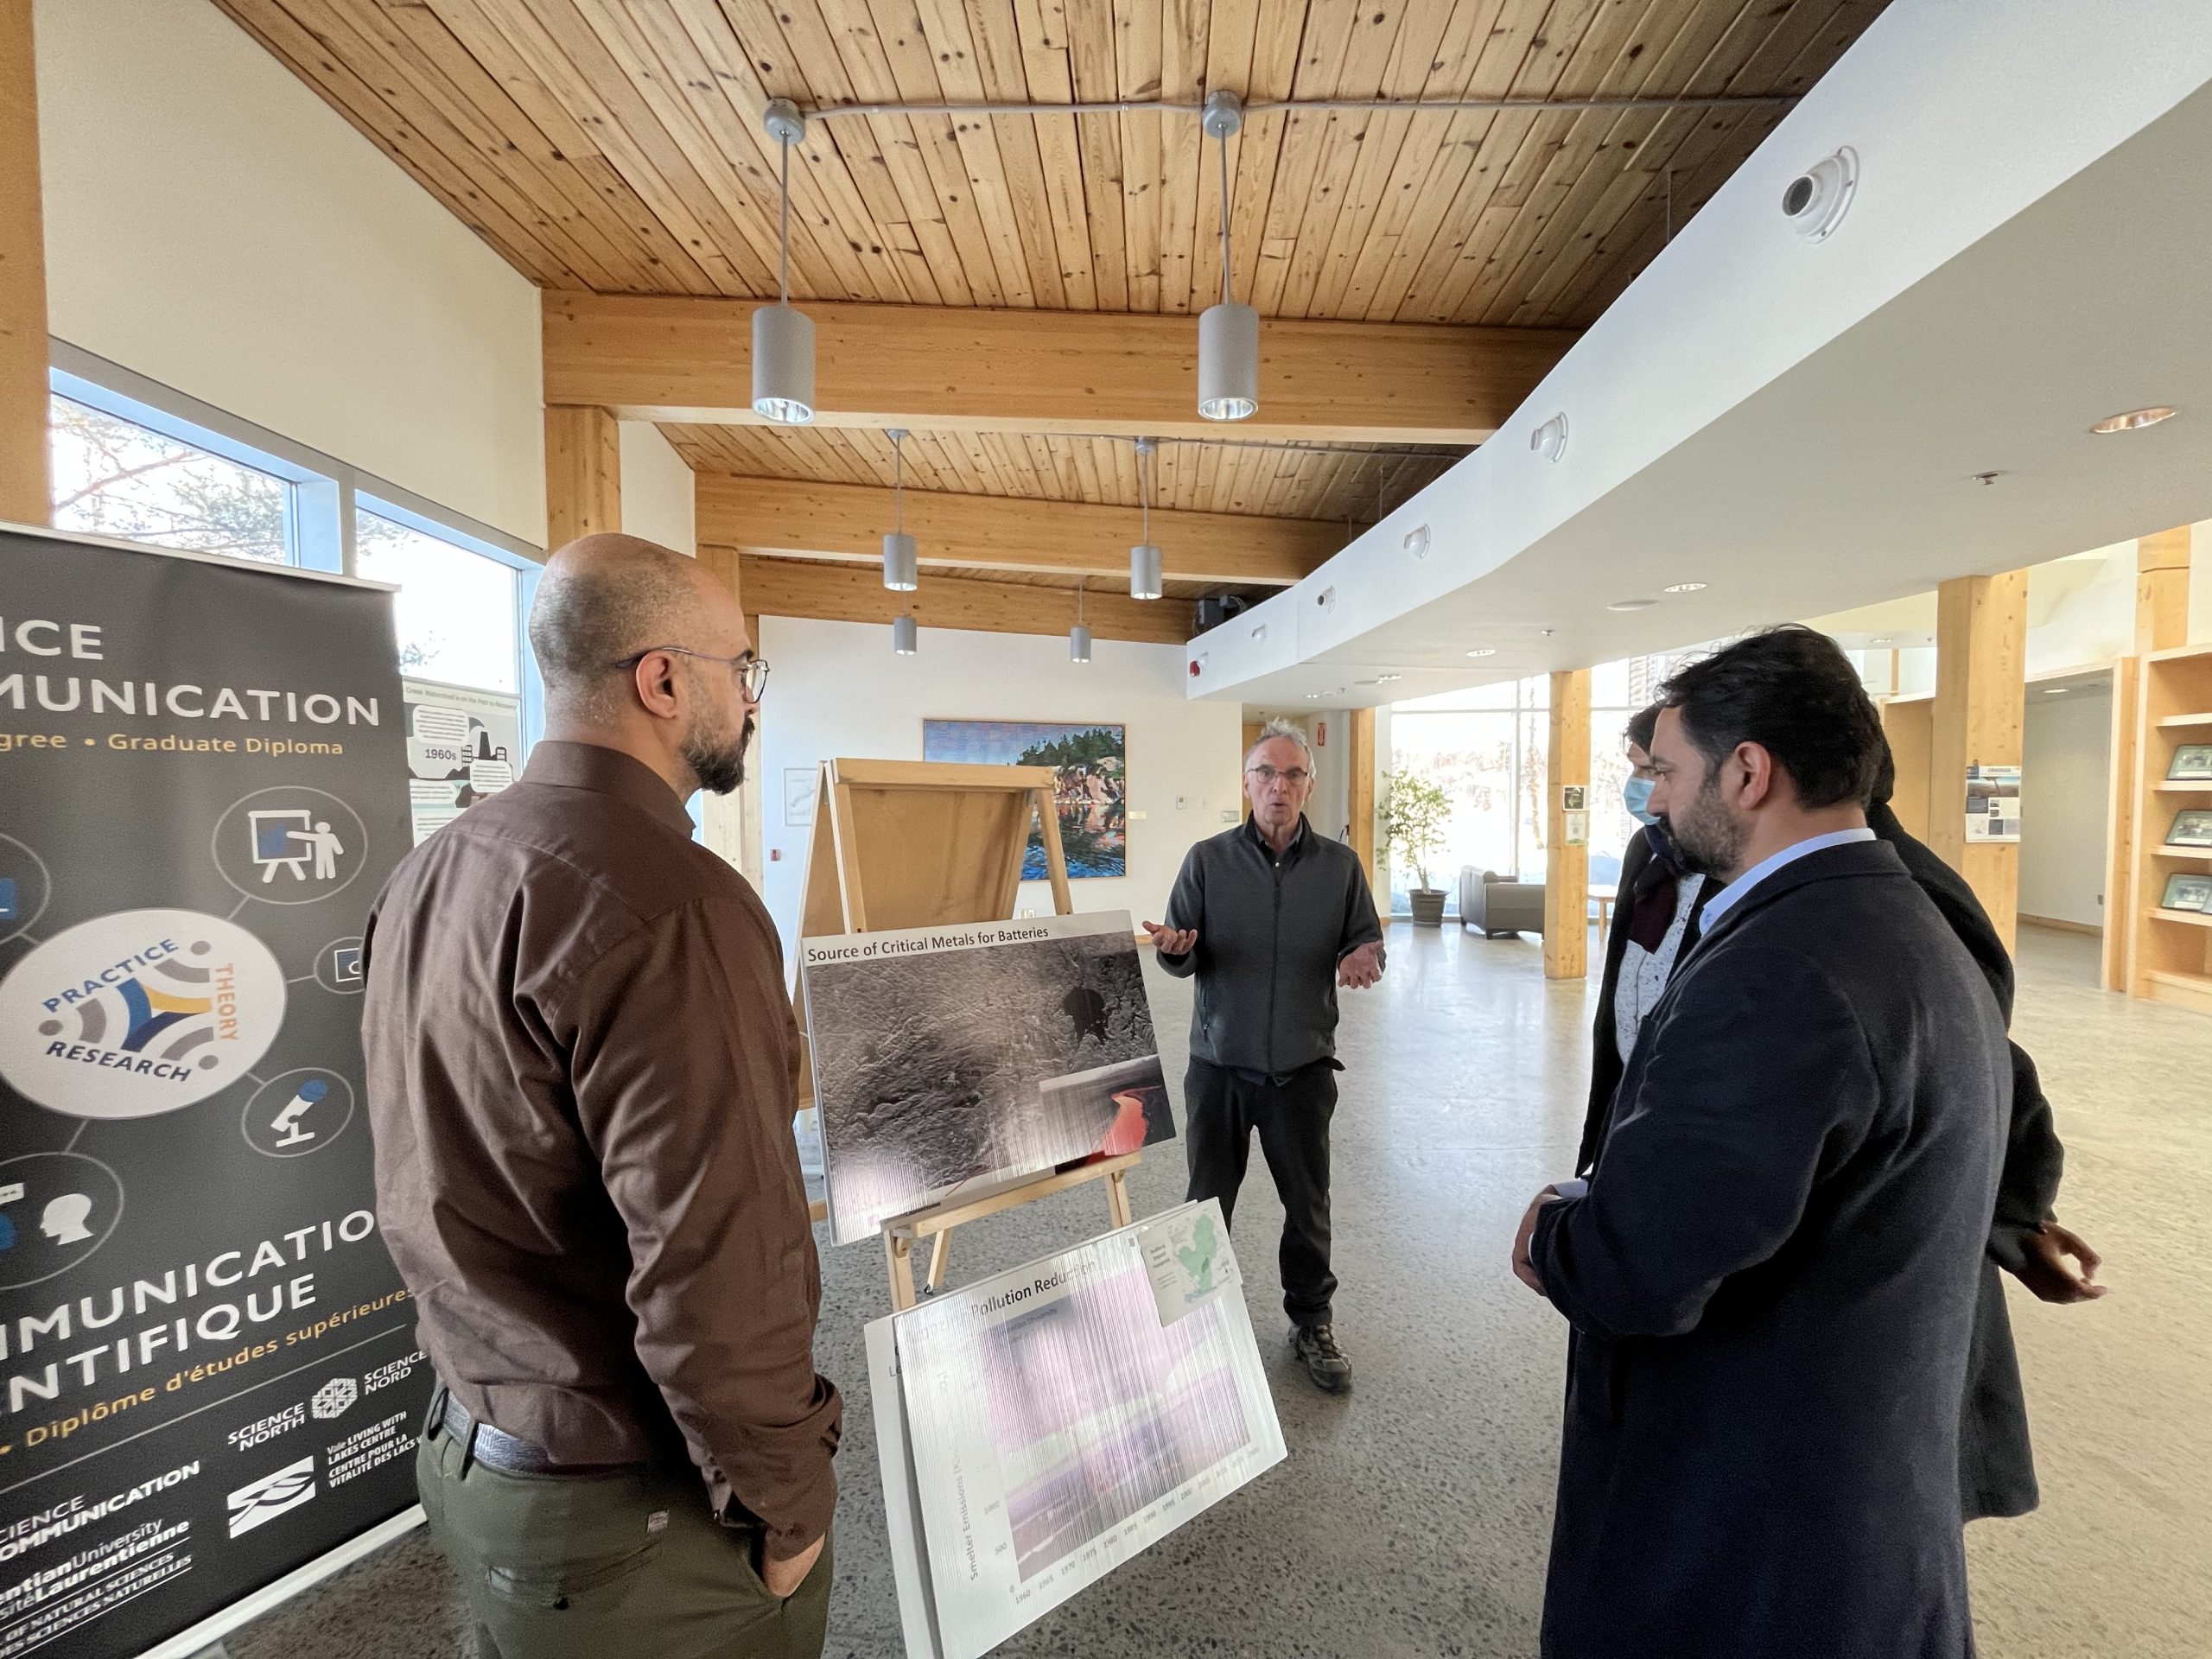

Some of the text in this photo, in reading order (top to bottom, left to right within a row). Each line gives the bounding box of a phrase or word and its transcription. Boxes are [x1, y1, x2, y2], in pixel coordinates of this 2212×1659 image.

[0, 616, 103, 660] CE
[108, 734, 236, 753] Graduate
[246, 738, 343, 757] Diploma
[425, 748, 457, 760] 1960s
[808, 926, 1048, 962] Source of Critical Metals for Batteries
[41, 938, 179, 1014] PRACTICE
[215, 963, 238, 1040] THEORY
[46, 1041, 192, 1082] RESEARCH
[0, 1211, 374, 1361] MUNICATIO
[971, 1287, 1032, 1319] Pollution
[364, 1351, 428, 1385] SCIENCE
[365, 1367, 411, 1395] NORD
[26, 1385, 156, 1447] Diplôme
[166, 1339, 278, 1390] d'études
[227, 1402, 304, 1445] SCIENCE
[239, 1414, 305, 1452] NORTH
[347, 1423, 381, 1446] LIVING
[381, 1410, 407, 1428] WITH
[328, 1426, 396, 1465] LAKES CENTRE
[328, 1433, 408, 1478] CENTRE POUR LA
[374, 1451, 392, 1466] DES
[393, 1439, 416, 1456] LACS
[956, 1475, 978, 1580] Smelter Emissions
